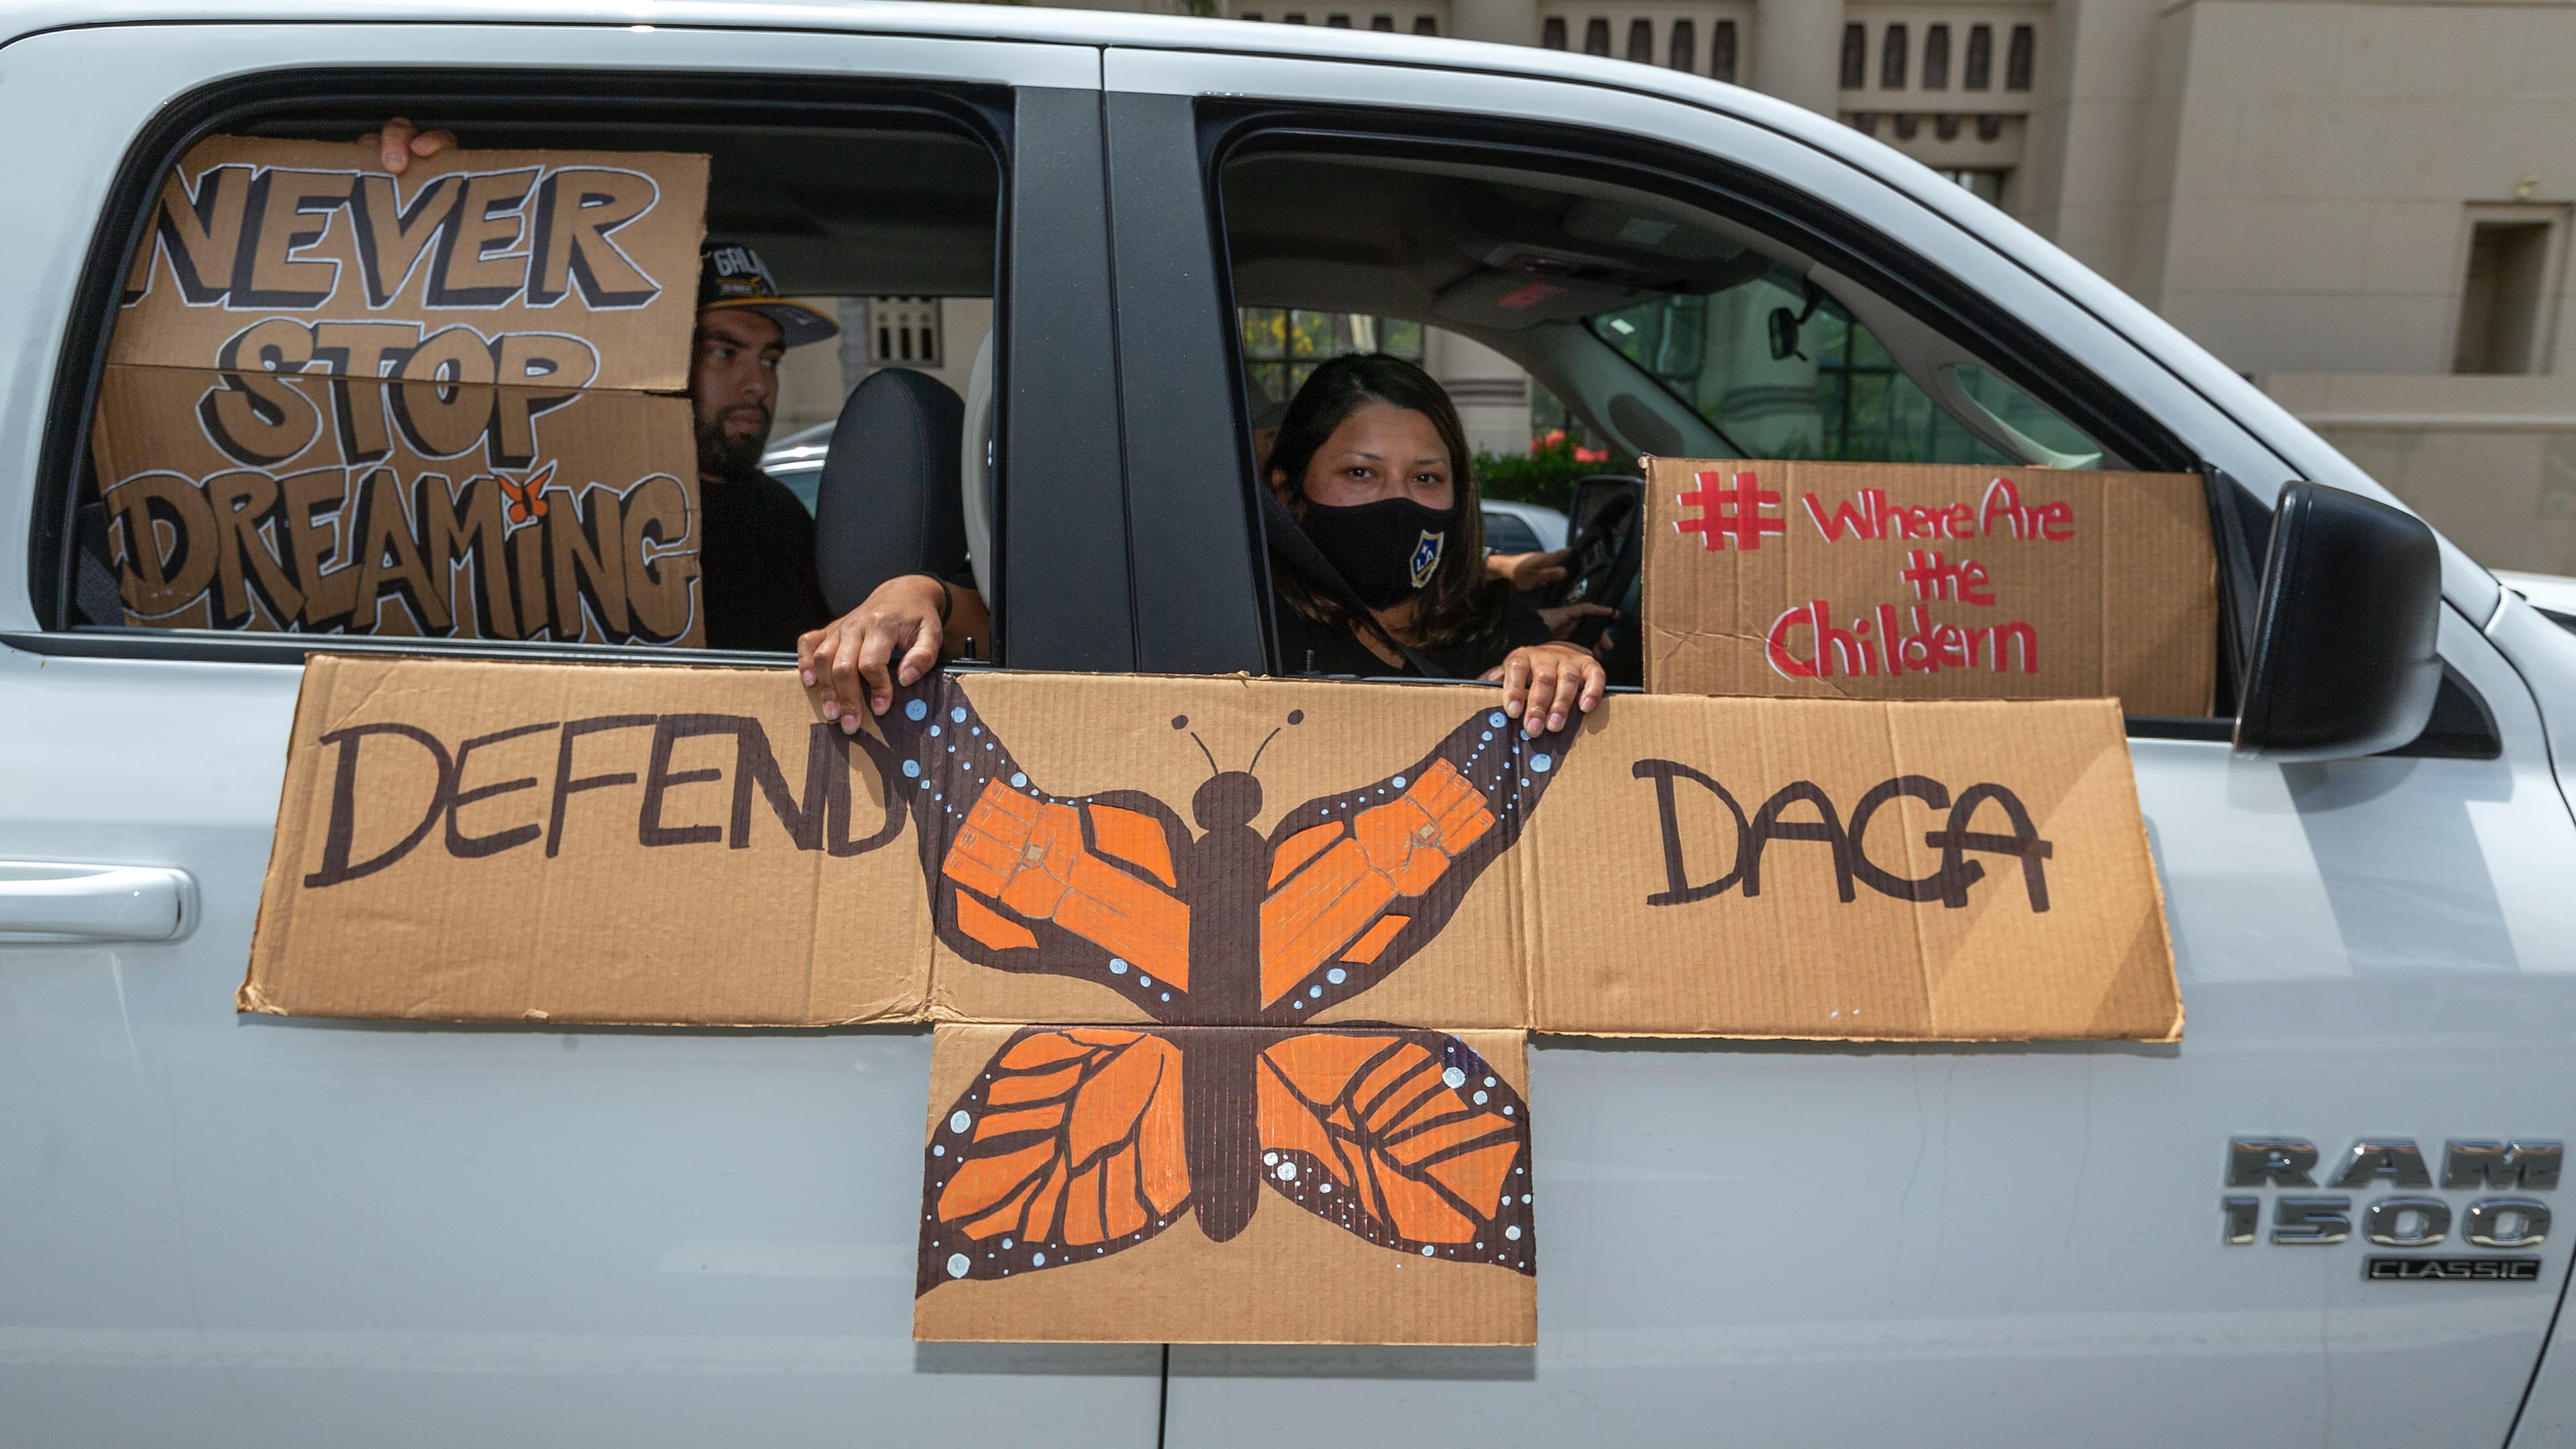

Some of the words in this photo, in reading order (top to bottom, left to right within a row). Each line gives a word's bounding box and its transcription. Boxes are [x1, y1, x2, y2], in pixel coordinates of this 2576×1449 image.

[121, 162, 662, 311] NEVER
[195, 316, 600, 471] STOP
[1899, 549, 1996, 607] the
[1764, 600, 2038, 683] Childern
[304, 713, 907, 888] DEFEND
[2226, 1138, 2564, 1189] RAM
[2222, 1196, 2552, 1246] 1500
[2371, 1260, 2537, 1279] CLASSIC
